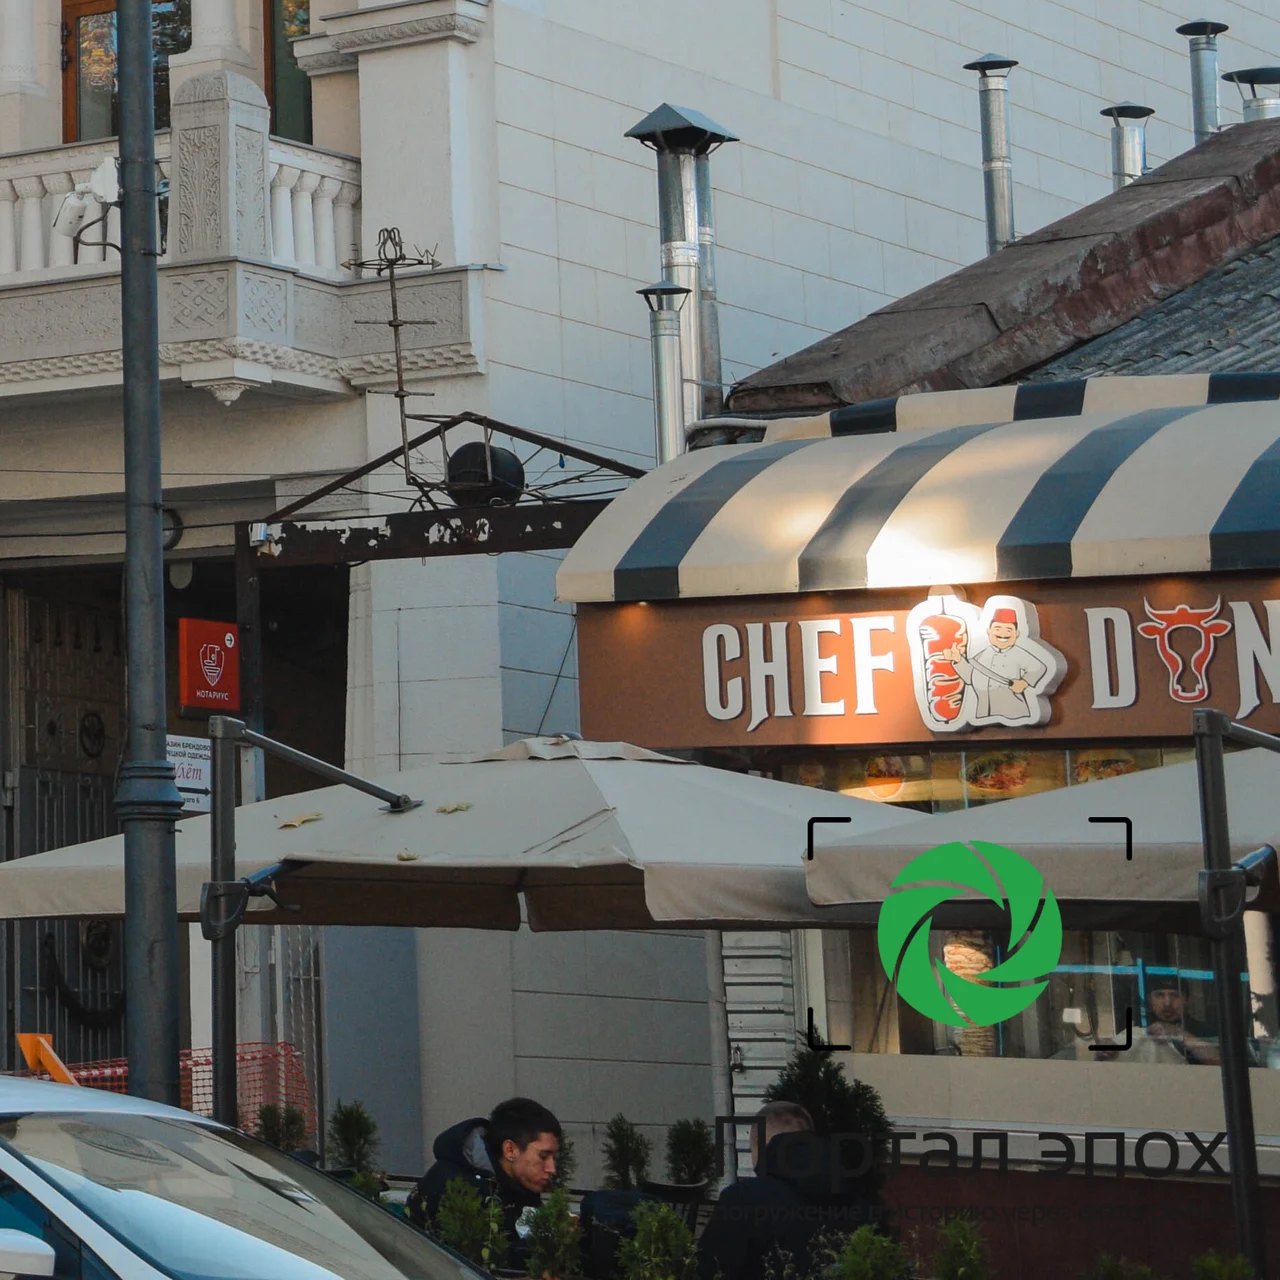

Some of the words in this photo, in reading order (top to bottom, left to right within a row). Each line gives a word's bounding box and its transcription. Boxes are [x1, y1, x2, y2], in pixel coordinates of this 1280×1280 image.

[702, 616, 895, 732] CHEF
[196, 689, 229, 701] НОТАРИУС
[166, 740, 181, 749] АЗИН
